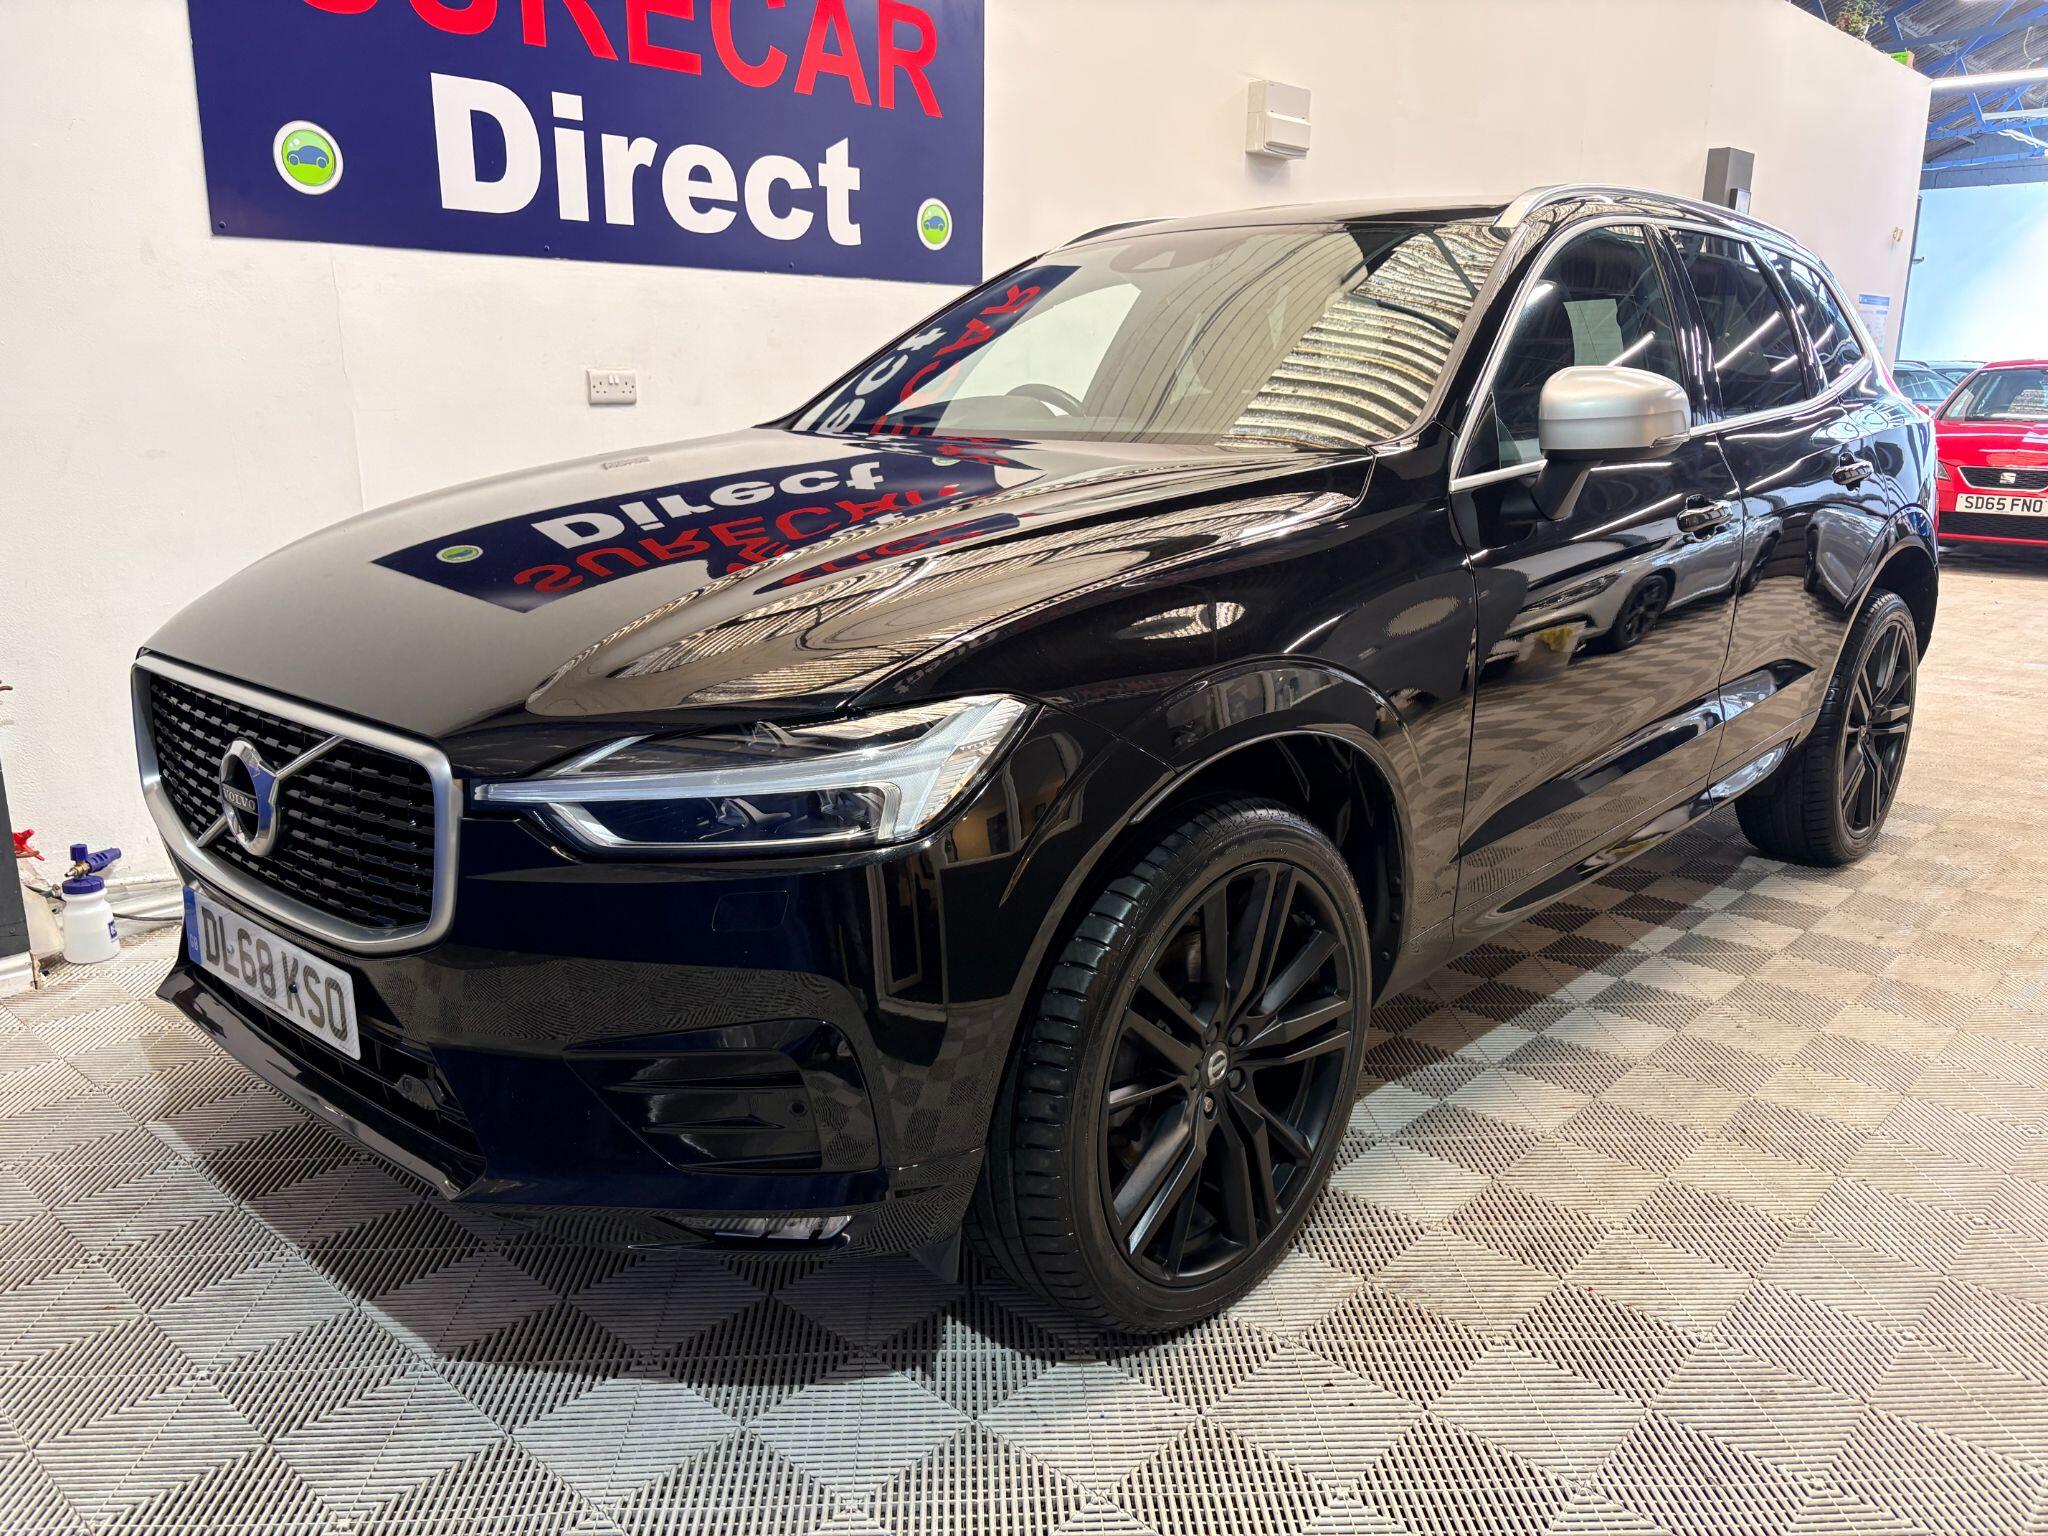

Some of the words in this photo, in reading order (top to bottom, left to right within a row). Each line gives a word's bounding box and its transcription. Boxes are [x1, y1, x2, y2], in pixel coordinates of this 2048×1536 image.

[303, 0, 943, 118] ECAR
[431, 72, 863, 246] Direct
[1964, 495, 2007, 511] SD65
[2010, 498, 2043, 513] FNO
[222, 787, 255, 810] VOLVO
[201, 906, 277, 1000] DL68
[281, 950, 348, 1042] KSO
